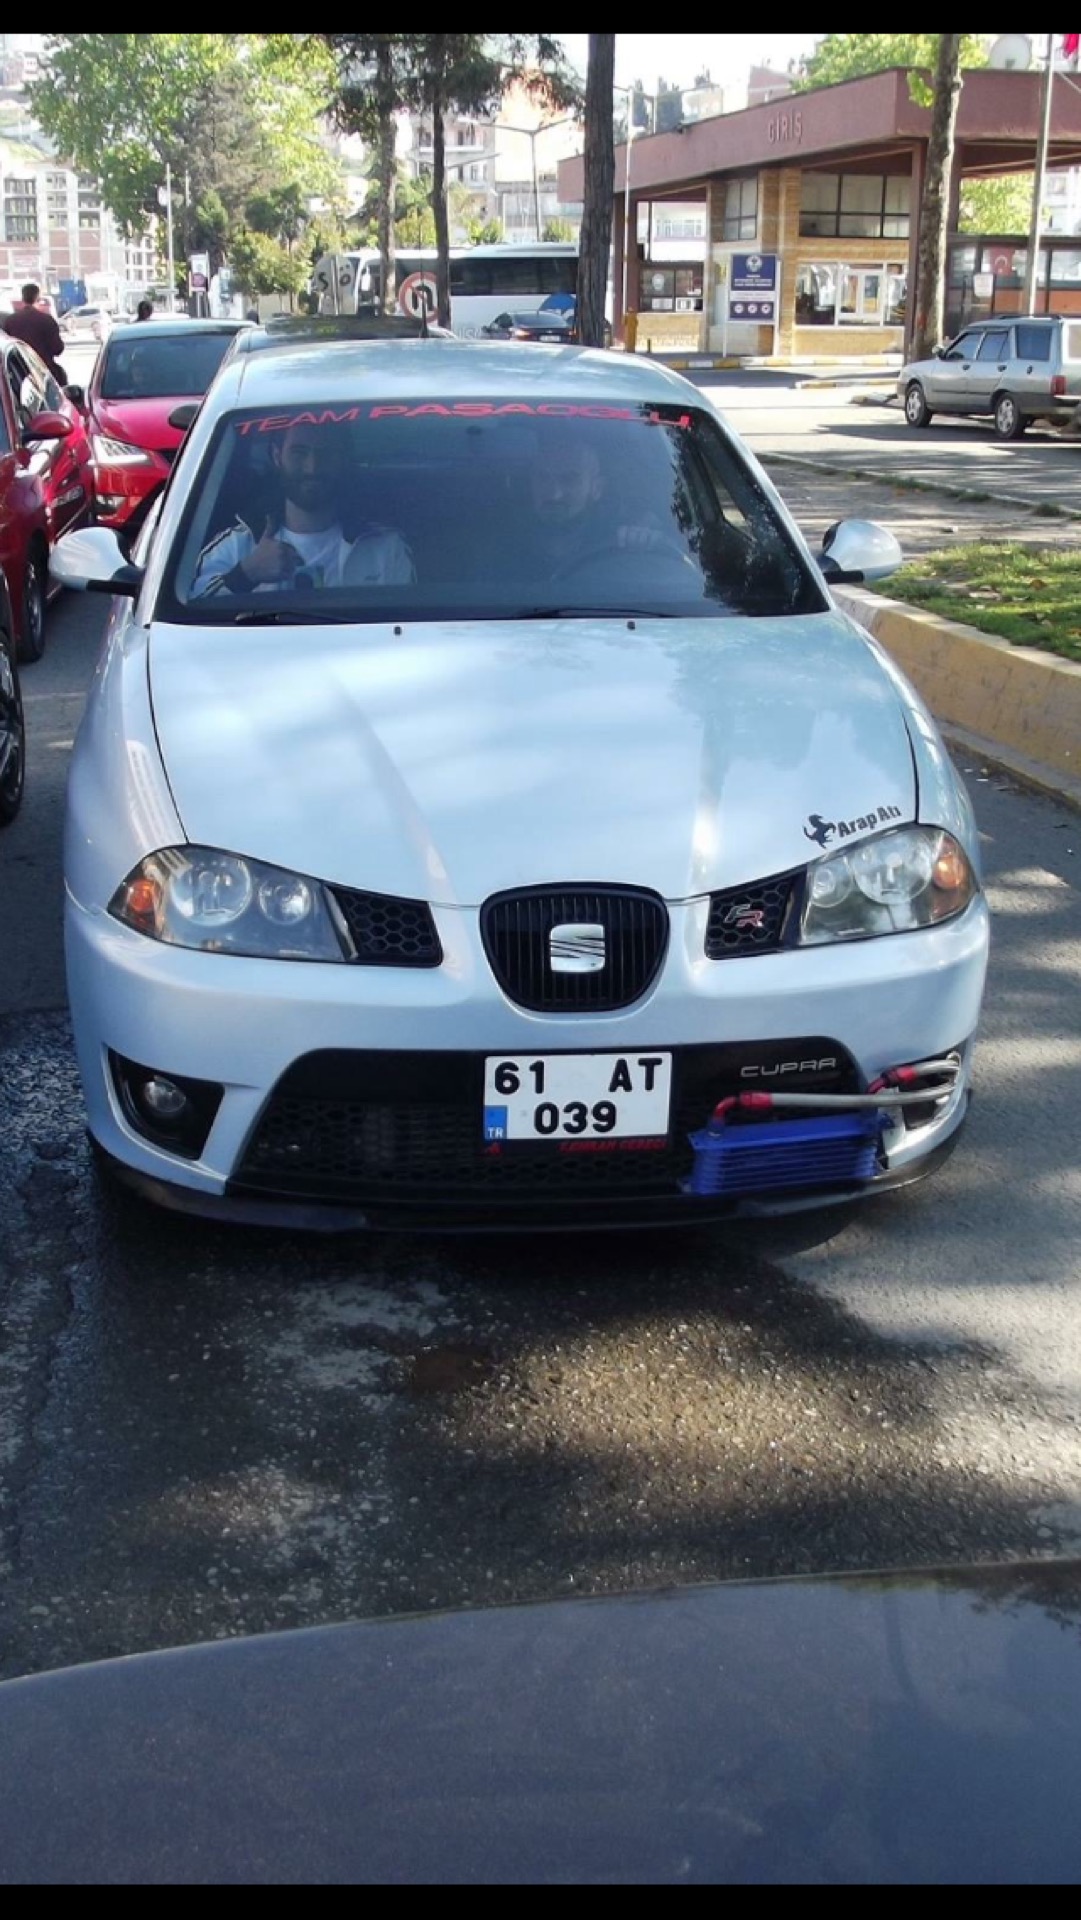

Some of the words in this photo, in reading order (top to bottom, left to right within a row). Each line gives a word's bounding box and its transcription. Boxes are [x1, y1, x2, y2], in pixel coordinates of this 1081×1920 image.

[768, 110, 802, 144] GİRİŞ
[236, 407, 361, 435] TEAM
[838, 813, 878, 838] Arap
[723, 903, 764, 927] FR
[494, 1060, 545, 1095] 61
[608, 1057, 663, 1093] AT
[740, 1057, 837, 1078] CUPRA
[488, 1127, 504, 1138] TR
[534, 1100, 617, 1135] 039
